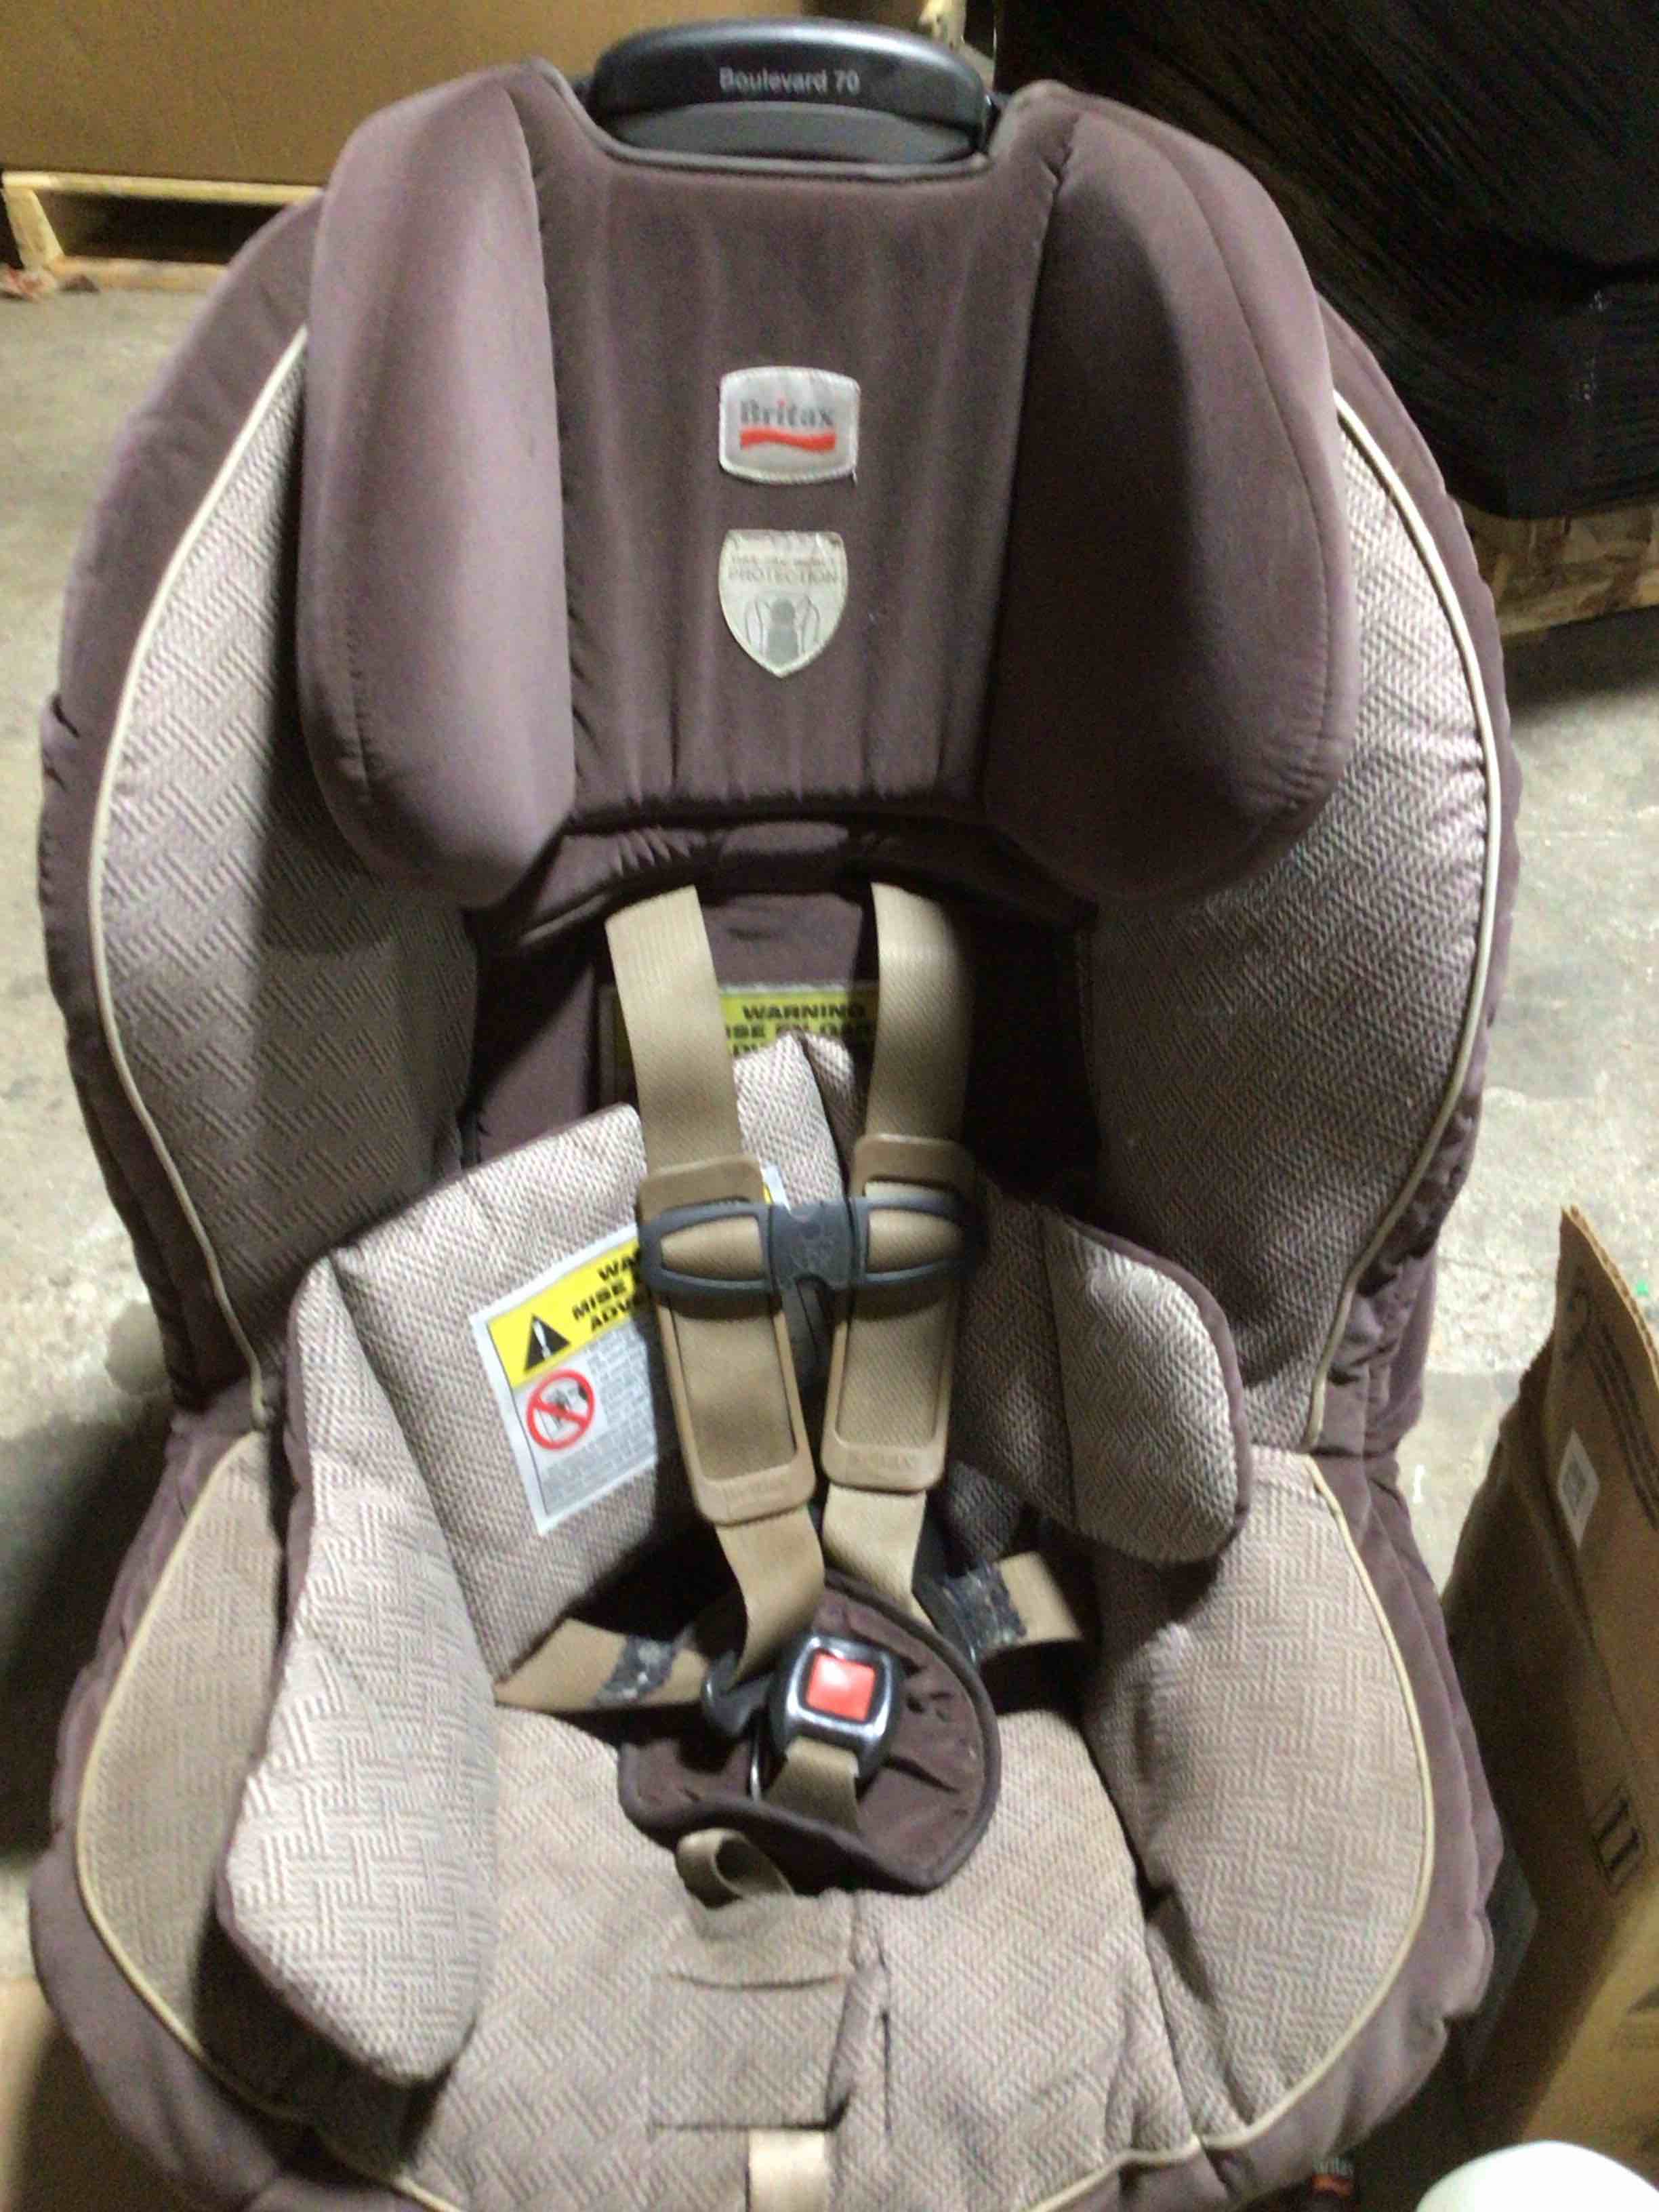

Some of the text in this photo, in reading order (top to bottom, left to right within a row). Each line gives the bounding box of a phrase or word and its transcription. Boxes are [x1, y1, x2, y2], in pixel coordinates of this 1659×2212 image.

[719, 66, 861, 94] Boulevard 70
[741, 397, 834, 427] Britax
[743, 1004, 866, 1019] WARNING
